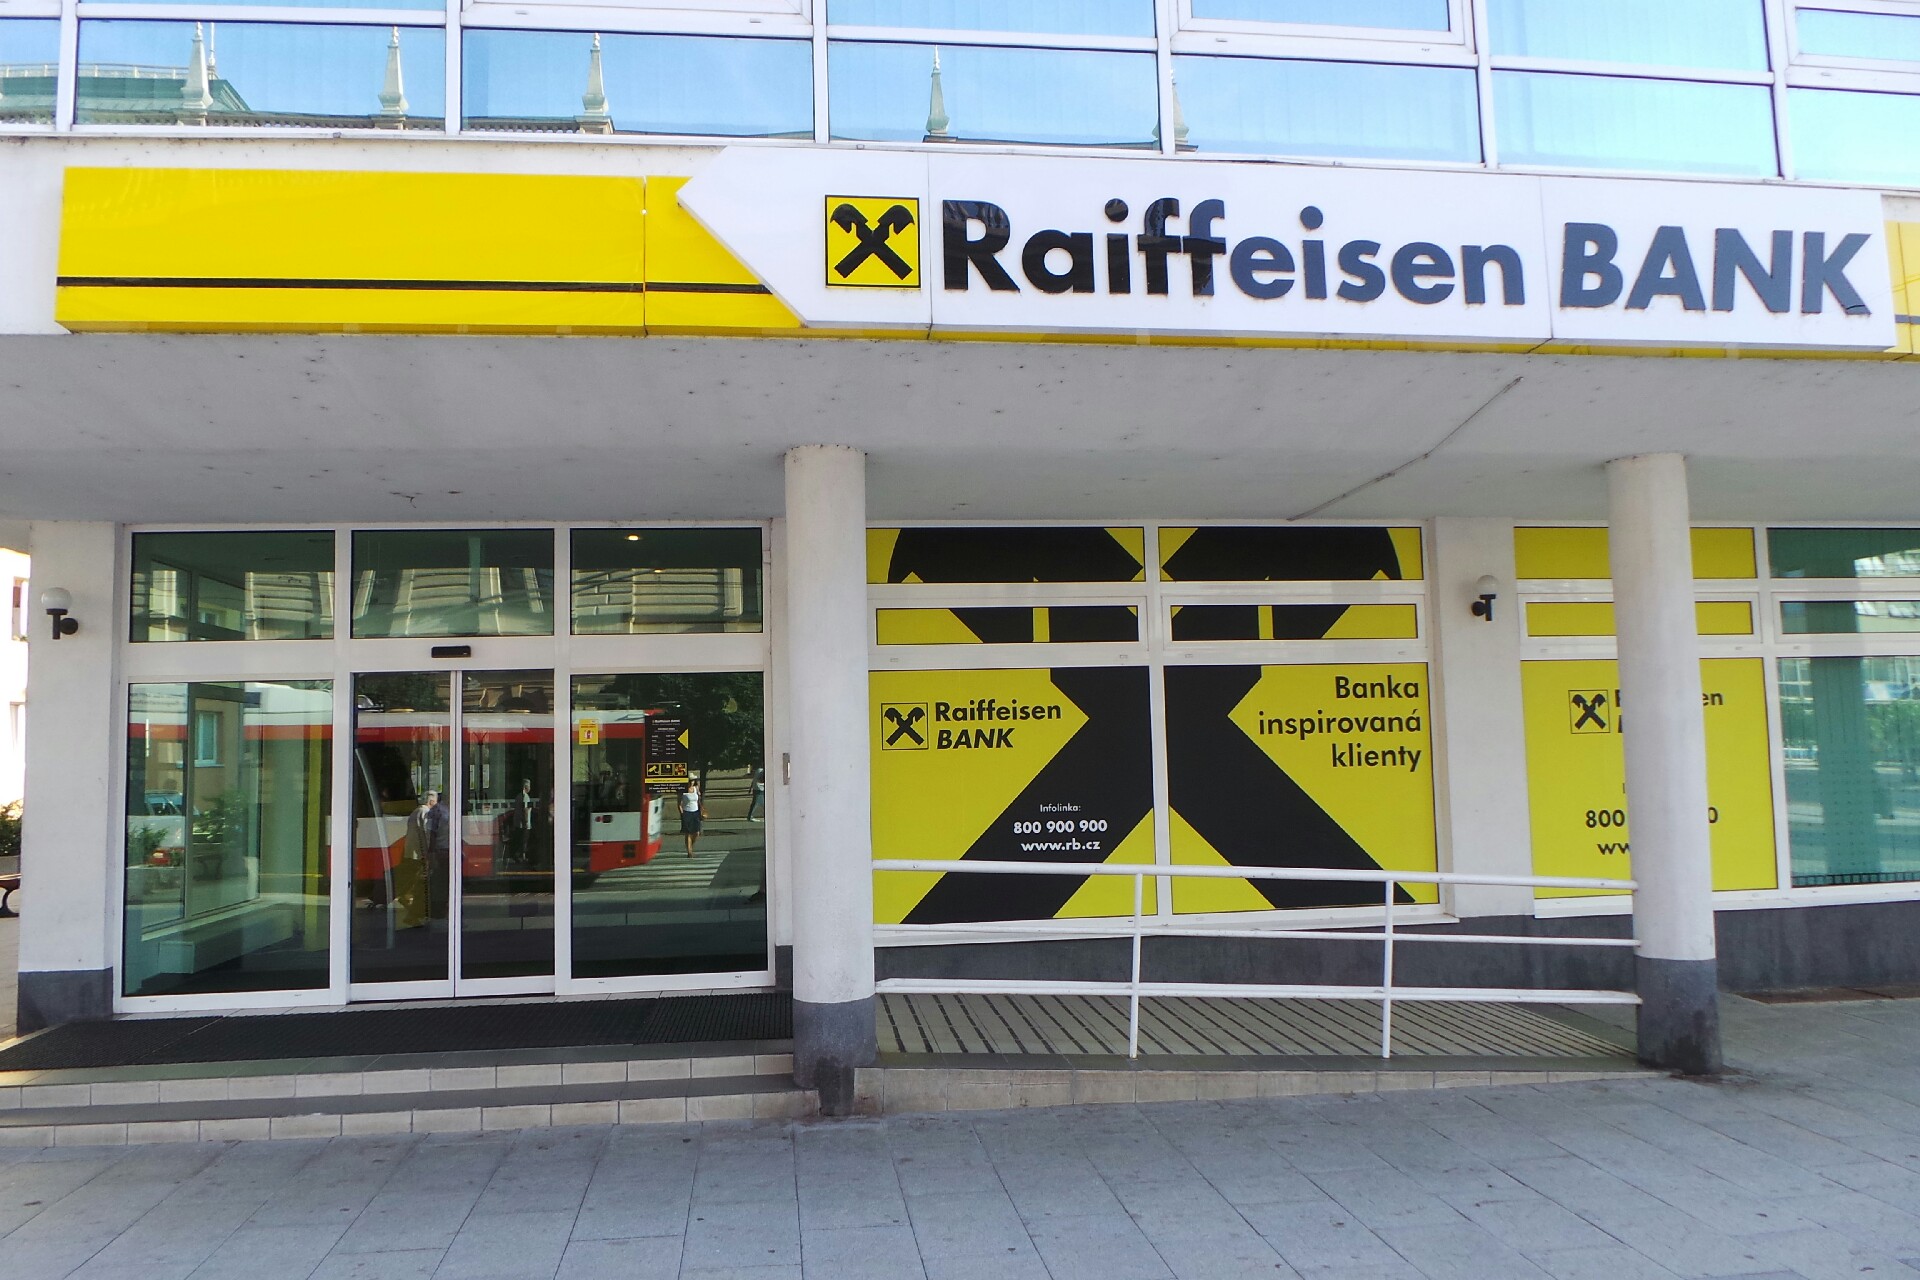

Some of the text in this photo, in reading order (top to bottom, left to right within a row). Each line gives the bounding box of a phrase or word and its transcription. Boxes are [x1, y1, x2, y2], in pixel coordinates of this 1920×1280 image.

[942, 197, 1872, 316] Raiffeisen BANK
[1335, 674, 1419, 699] Banka
[935, 699, 1061, 721] Raiffeisen
[1258, 708, 1422, 740] inspirovaná
[937, 728, 1015, 749] BANK
[1331, 742, 1422, 772] klienty
[1039, 803, 1082, 813] Infolinka:
[1585, 809, 1626, 828] 800
[1013, 819, 1108, 834] 800 900 900
[1021, 839, 1100, 851] www.rb.cz
